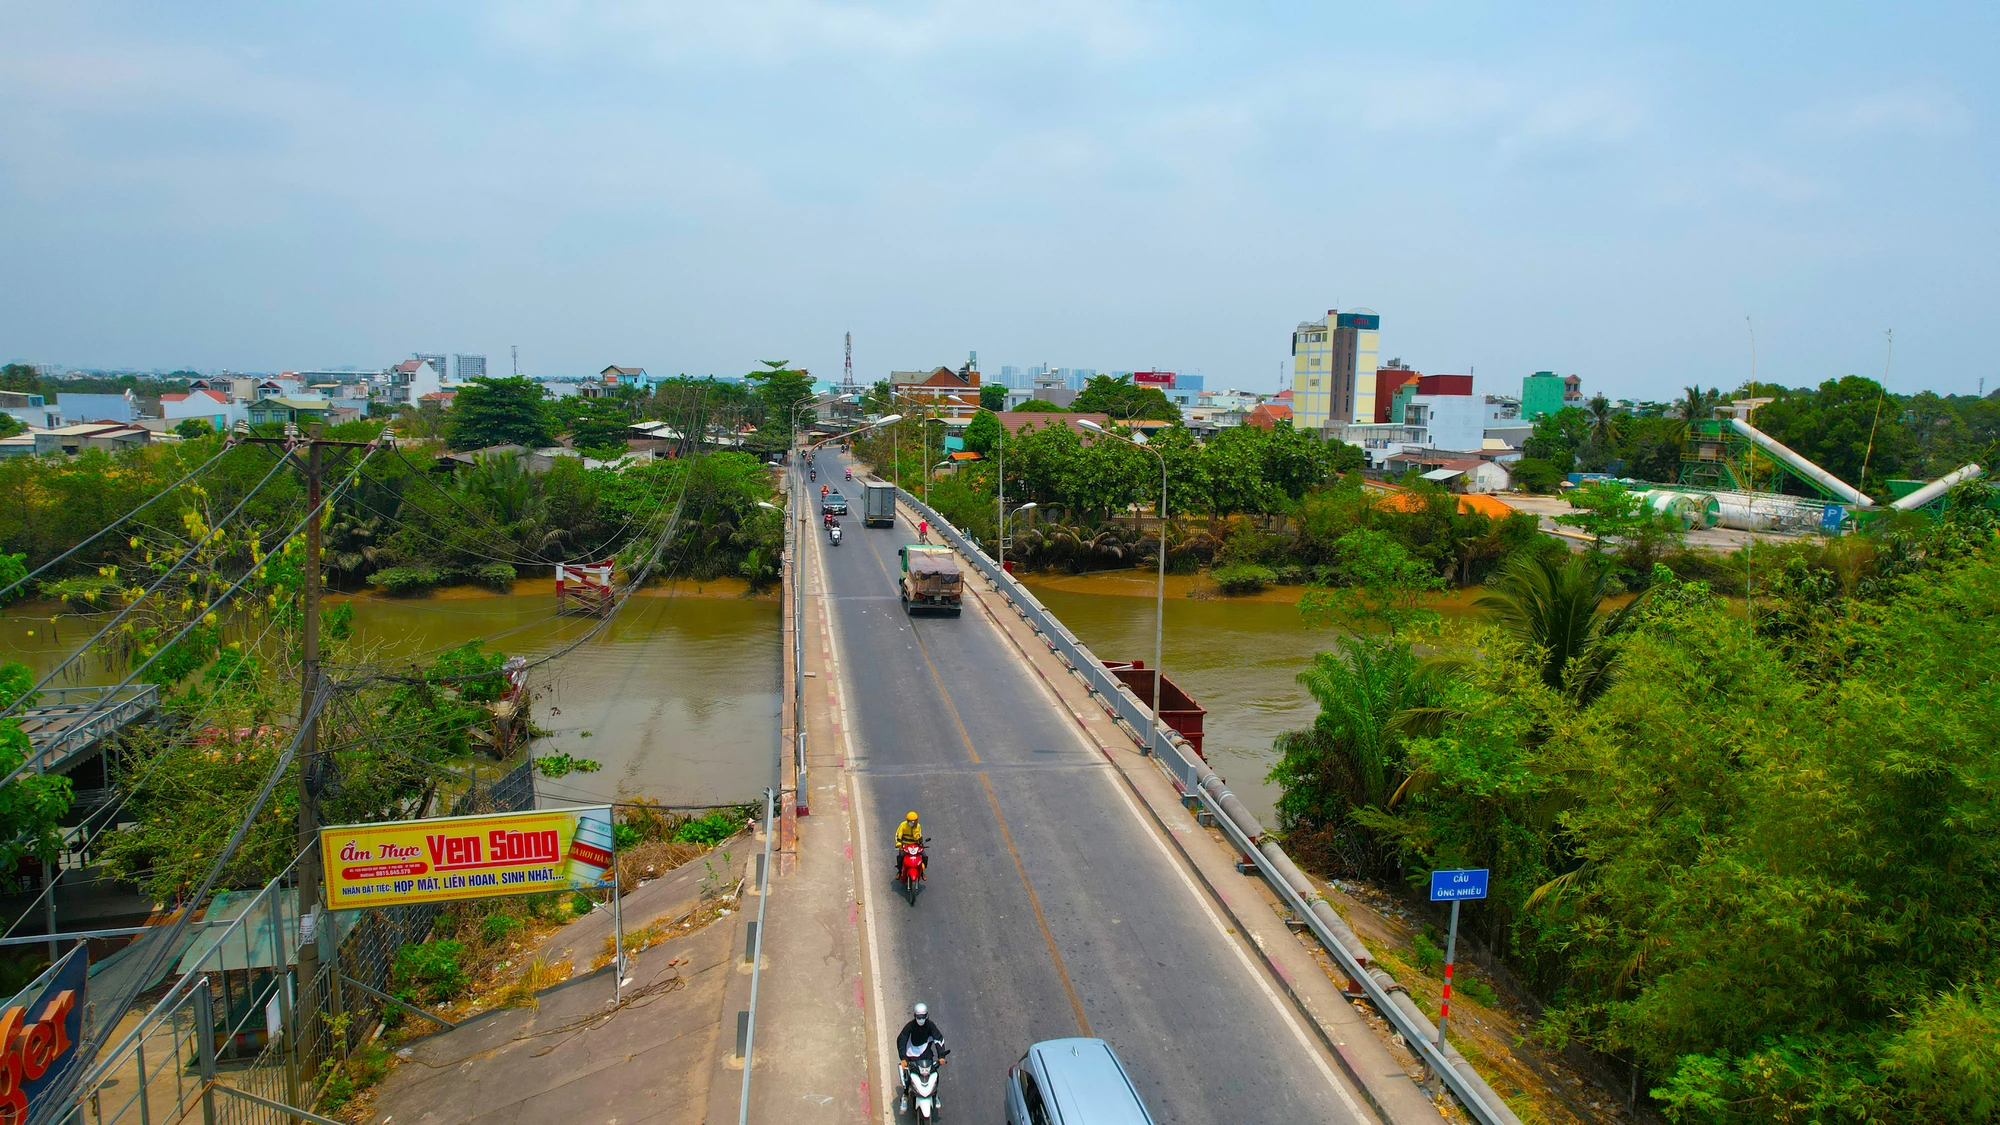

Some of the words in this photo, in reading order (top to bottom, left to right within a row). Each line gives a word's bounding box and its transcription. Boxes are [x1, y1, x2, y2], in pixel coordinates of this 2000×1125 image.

[340, 840, 372, 861] Ẩm
[378, 843, 422, 861] Thực
[426, 834, 482, 866] Ven
[489, 829, 560, 863] Sông
[394, 879, 414, 895] HỌP
[417, 875, 440, 893] MẶT,
[443, 873, 466, 889] LIÊN
[468, 873, 499, 888] HOAN,
[501, 870, 525, 885] SINH
[1453, 871, 1469, 883] CẦU
[1437, 887, 1455, 897] ÔNG
